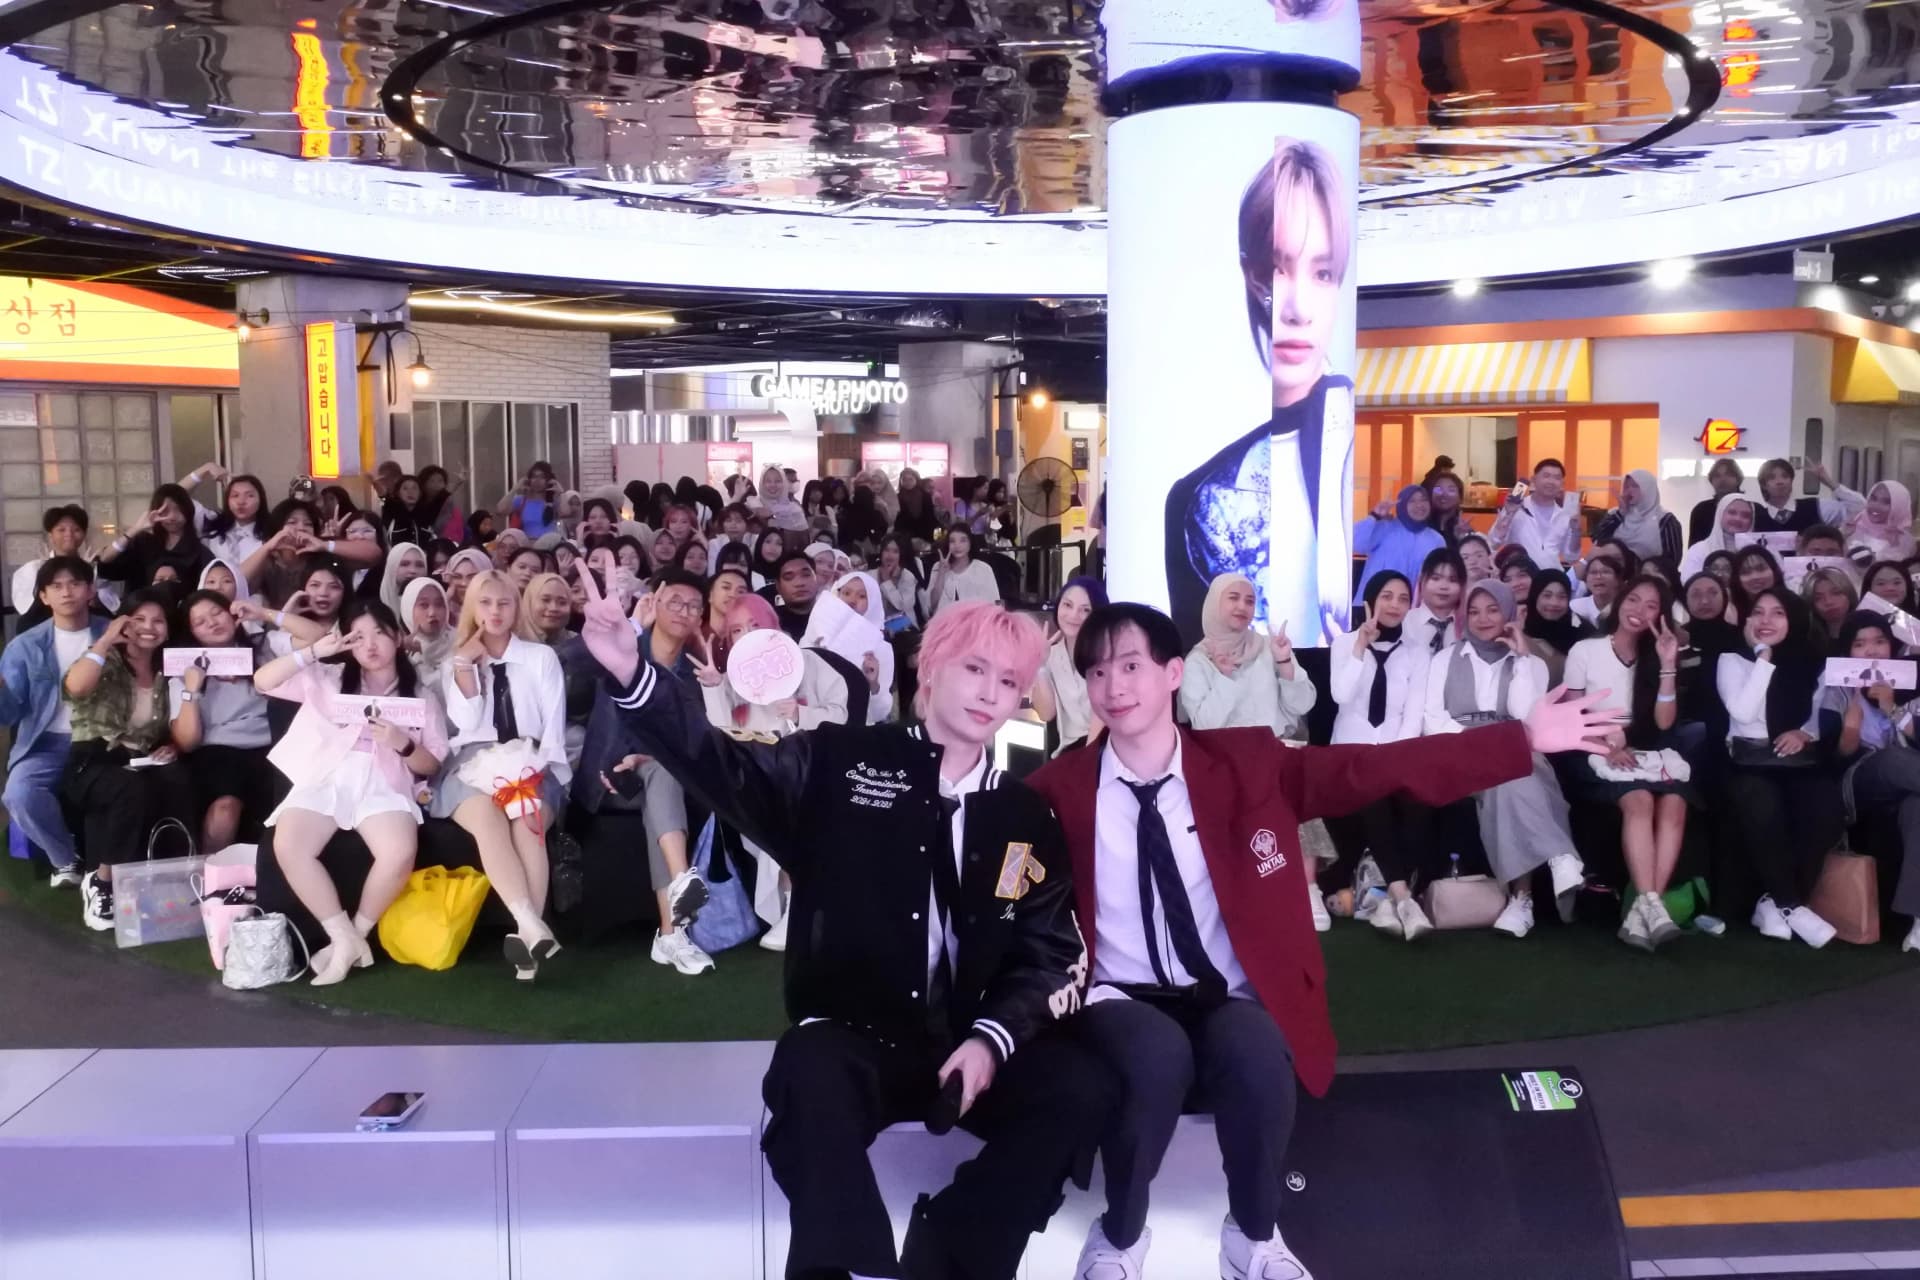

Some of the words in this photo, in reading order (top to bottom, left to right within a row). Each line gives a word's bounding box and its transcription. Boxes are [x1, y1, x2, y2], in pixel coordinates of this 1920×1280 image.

[5, 295, 77, 337] 상점
[316, 337, 332, 459] 고맙습니다
[759, 374, 909, 405] GAME&PHOTO
[1257, 853, 1286, 874] UNTAR
